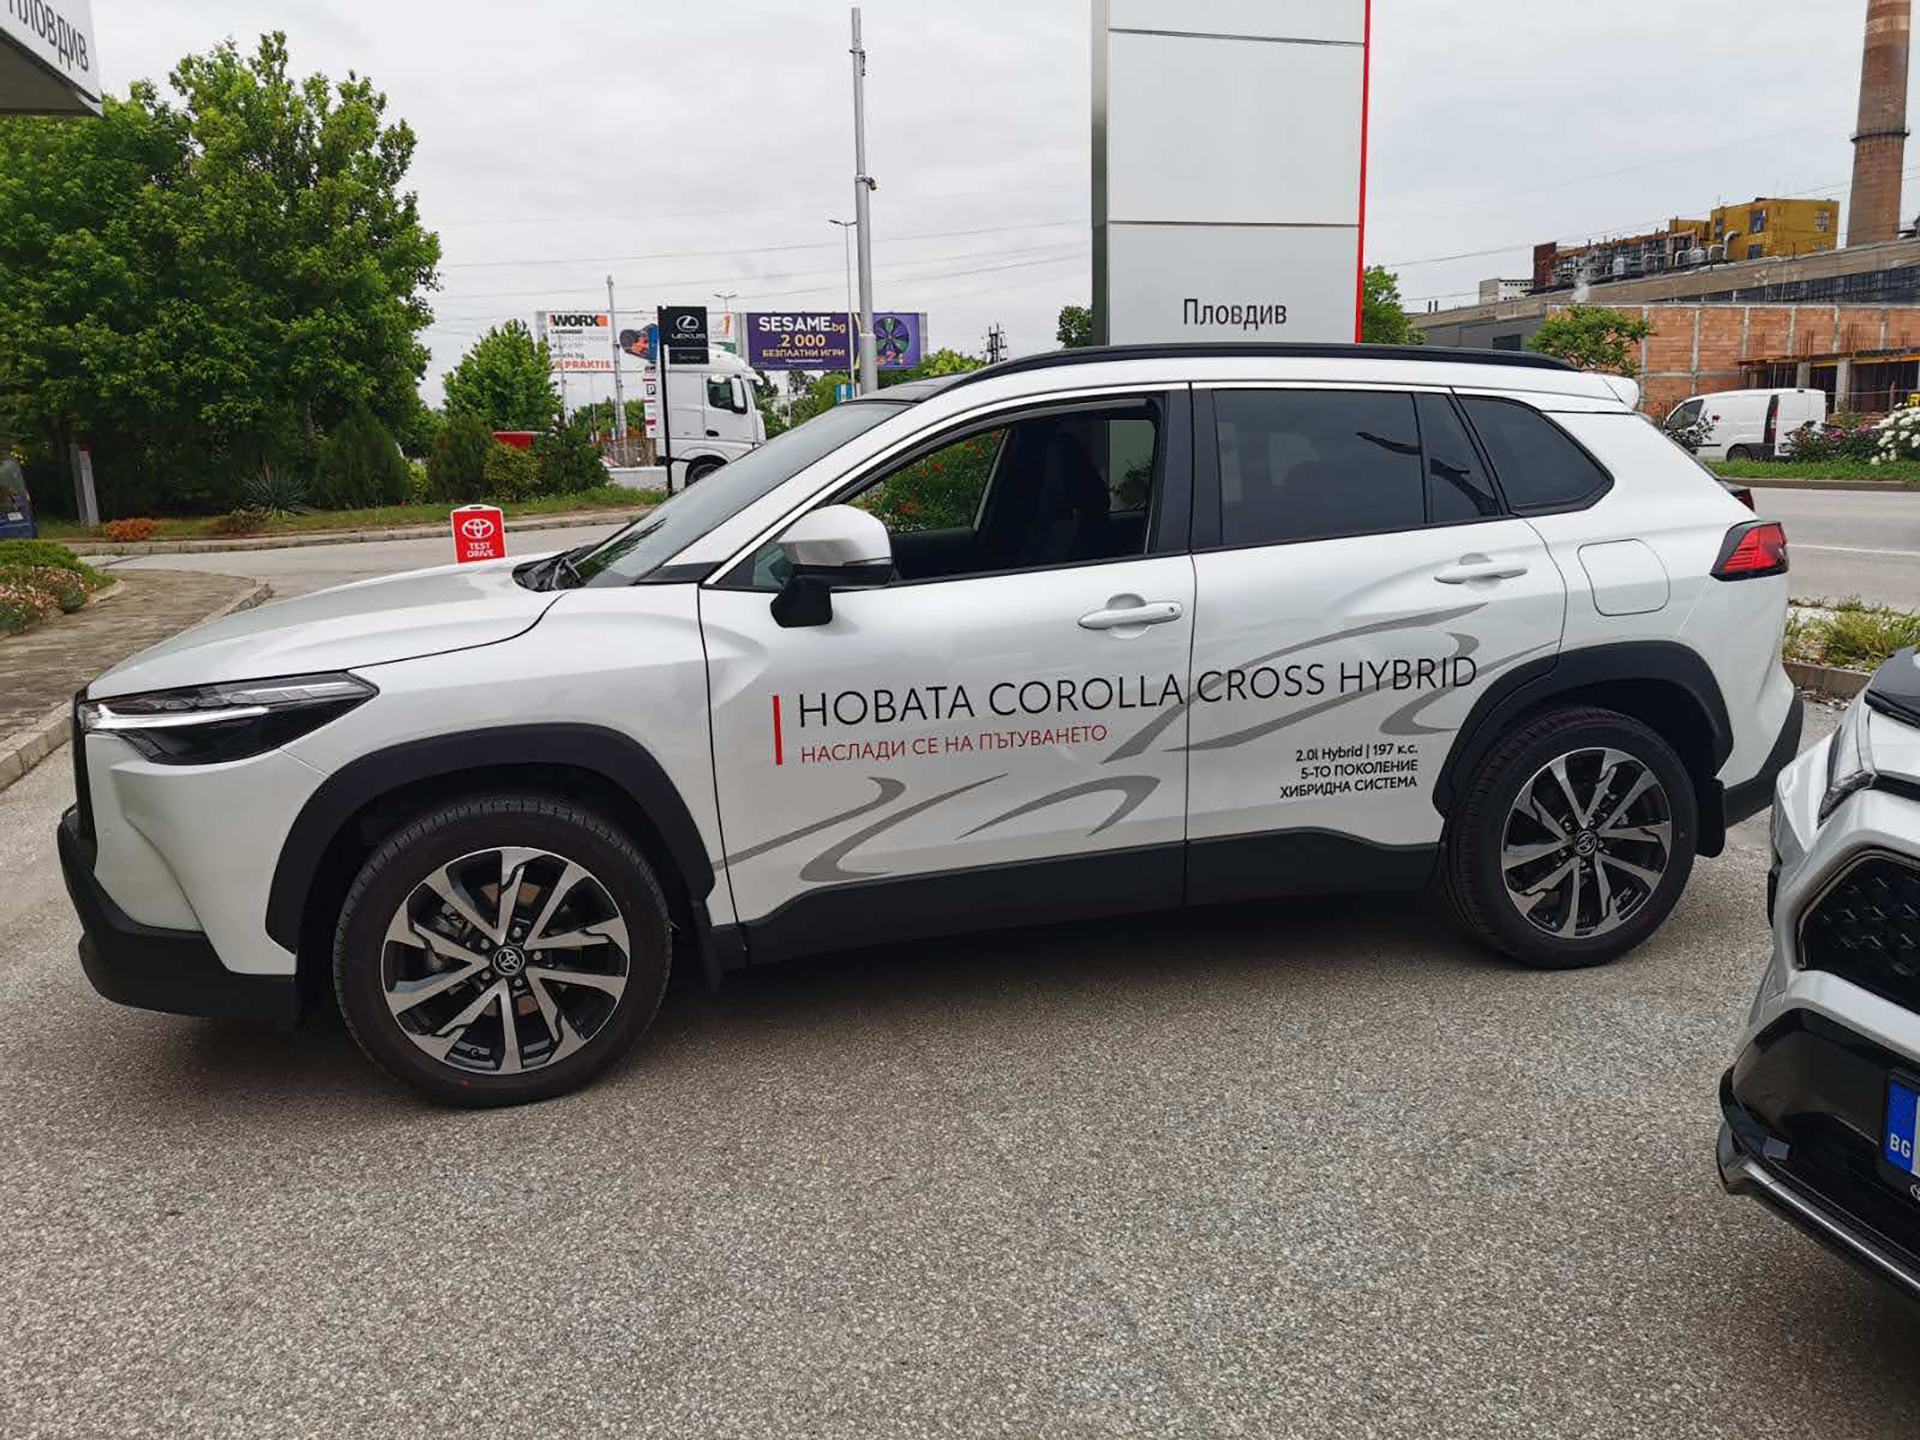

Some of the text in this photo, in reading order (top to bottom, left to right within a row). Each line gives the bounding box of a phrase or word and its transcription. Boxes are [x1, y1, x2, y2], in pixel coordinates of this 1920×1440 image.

[551, 314, 601, 327] WORX
[1183, 298, 1287, 331] Пловдив
[794, 334, 826, 347] 000
[762, 348, 845, 358] БЕЗПЛАТНИ ИГРИ
[564, 360, 611, 369] PRAKTIS
[466, 549, 495, 558] DRIVE
[469, 542, 490, 550] TEST
[798, 655, 1478, 728] НОВАТА COROLLA CROSS HYBRID
[800, 724, 1108, 764] НАСЛАДИ СЕ НА ПЪТУВАНЕТО
[1321, 744, 1363, 762] Hybrid
[1372, 742, 1395, 756] 197
[1397, 744, 1419, 755] к.с.
[1300, 758, 1418, 780] 5-ТО ПОКОЛЕНИЕ
[1279, 775, 1418, 799] ХИБРИДНА СИСТЕМА
[1889, 1132, 1911, 1160] BG
